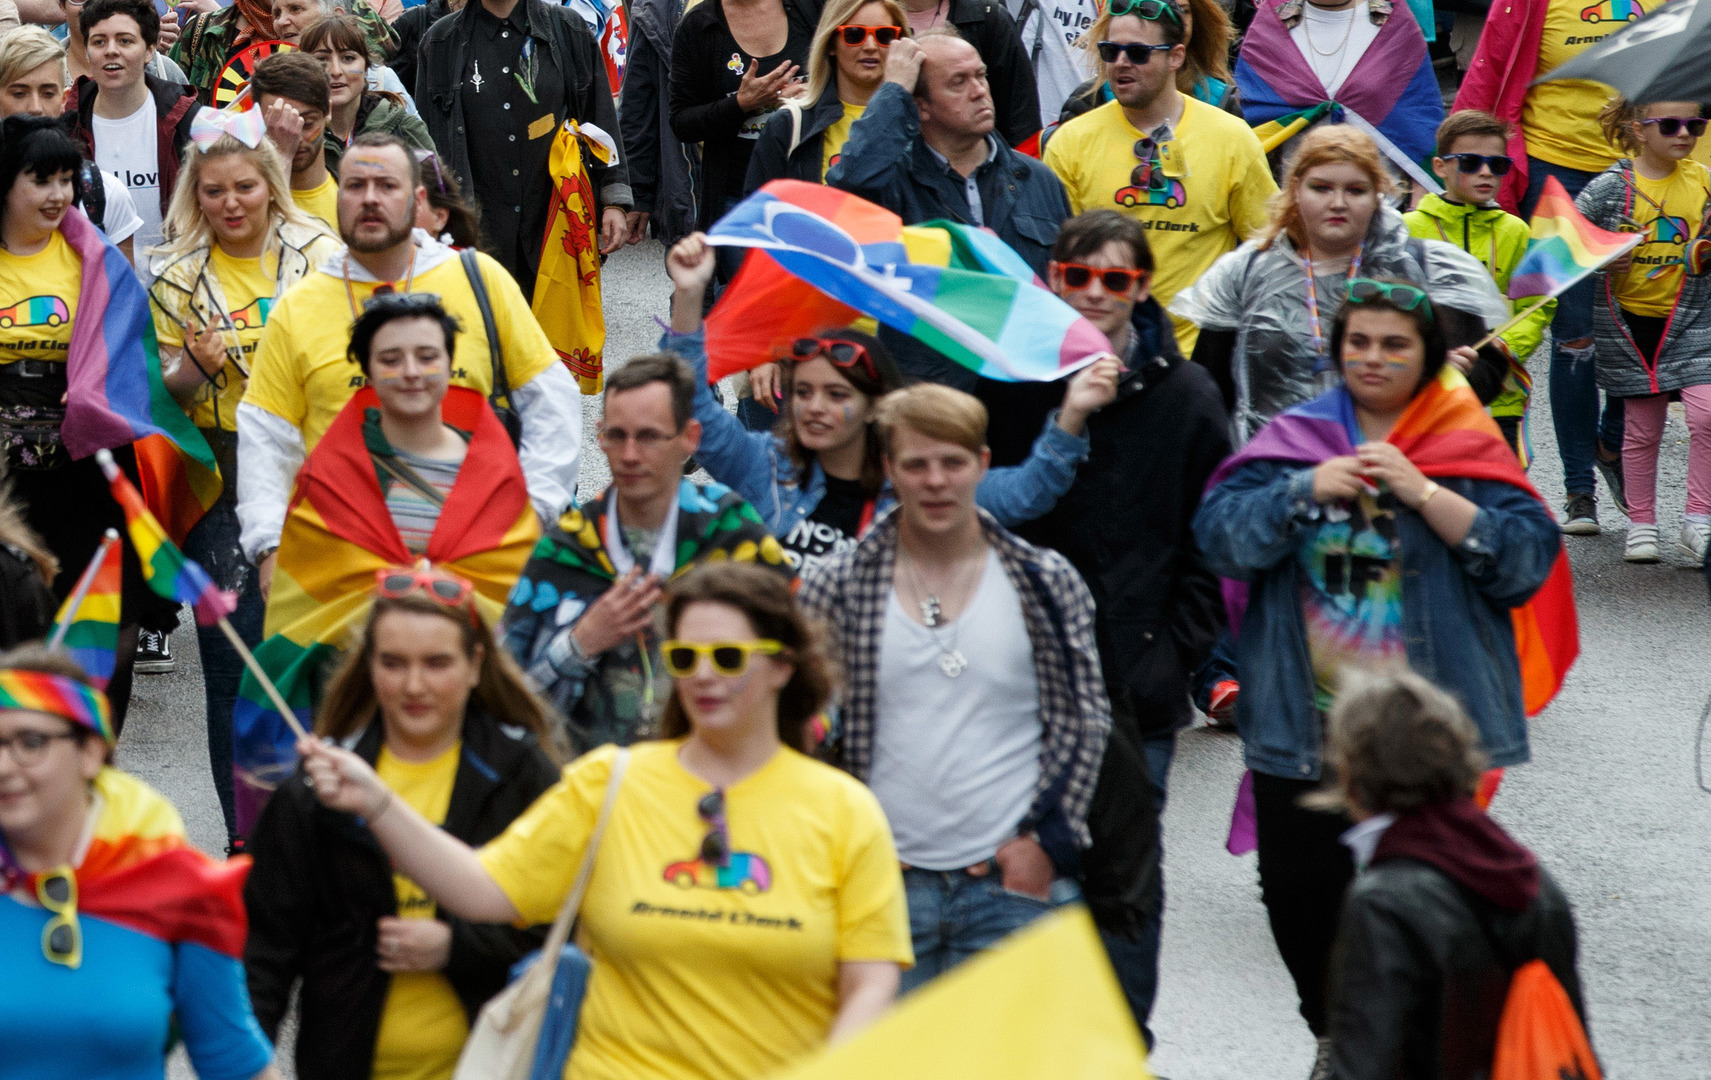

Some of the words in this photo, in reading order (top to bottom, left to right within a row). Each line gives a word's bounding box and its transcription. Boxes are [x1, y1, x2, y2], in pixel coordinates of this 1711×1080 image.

[126, 171, 160, 187] lov
[1155, 220, 1199, 233] Clark
[38, 338, 69, 351] Cla
